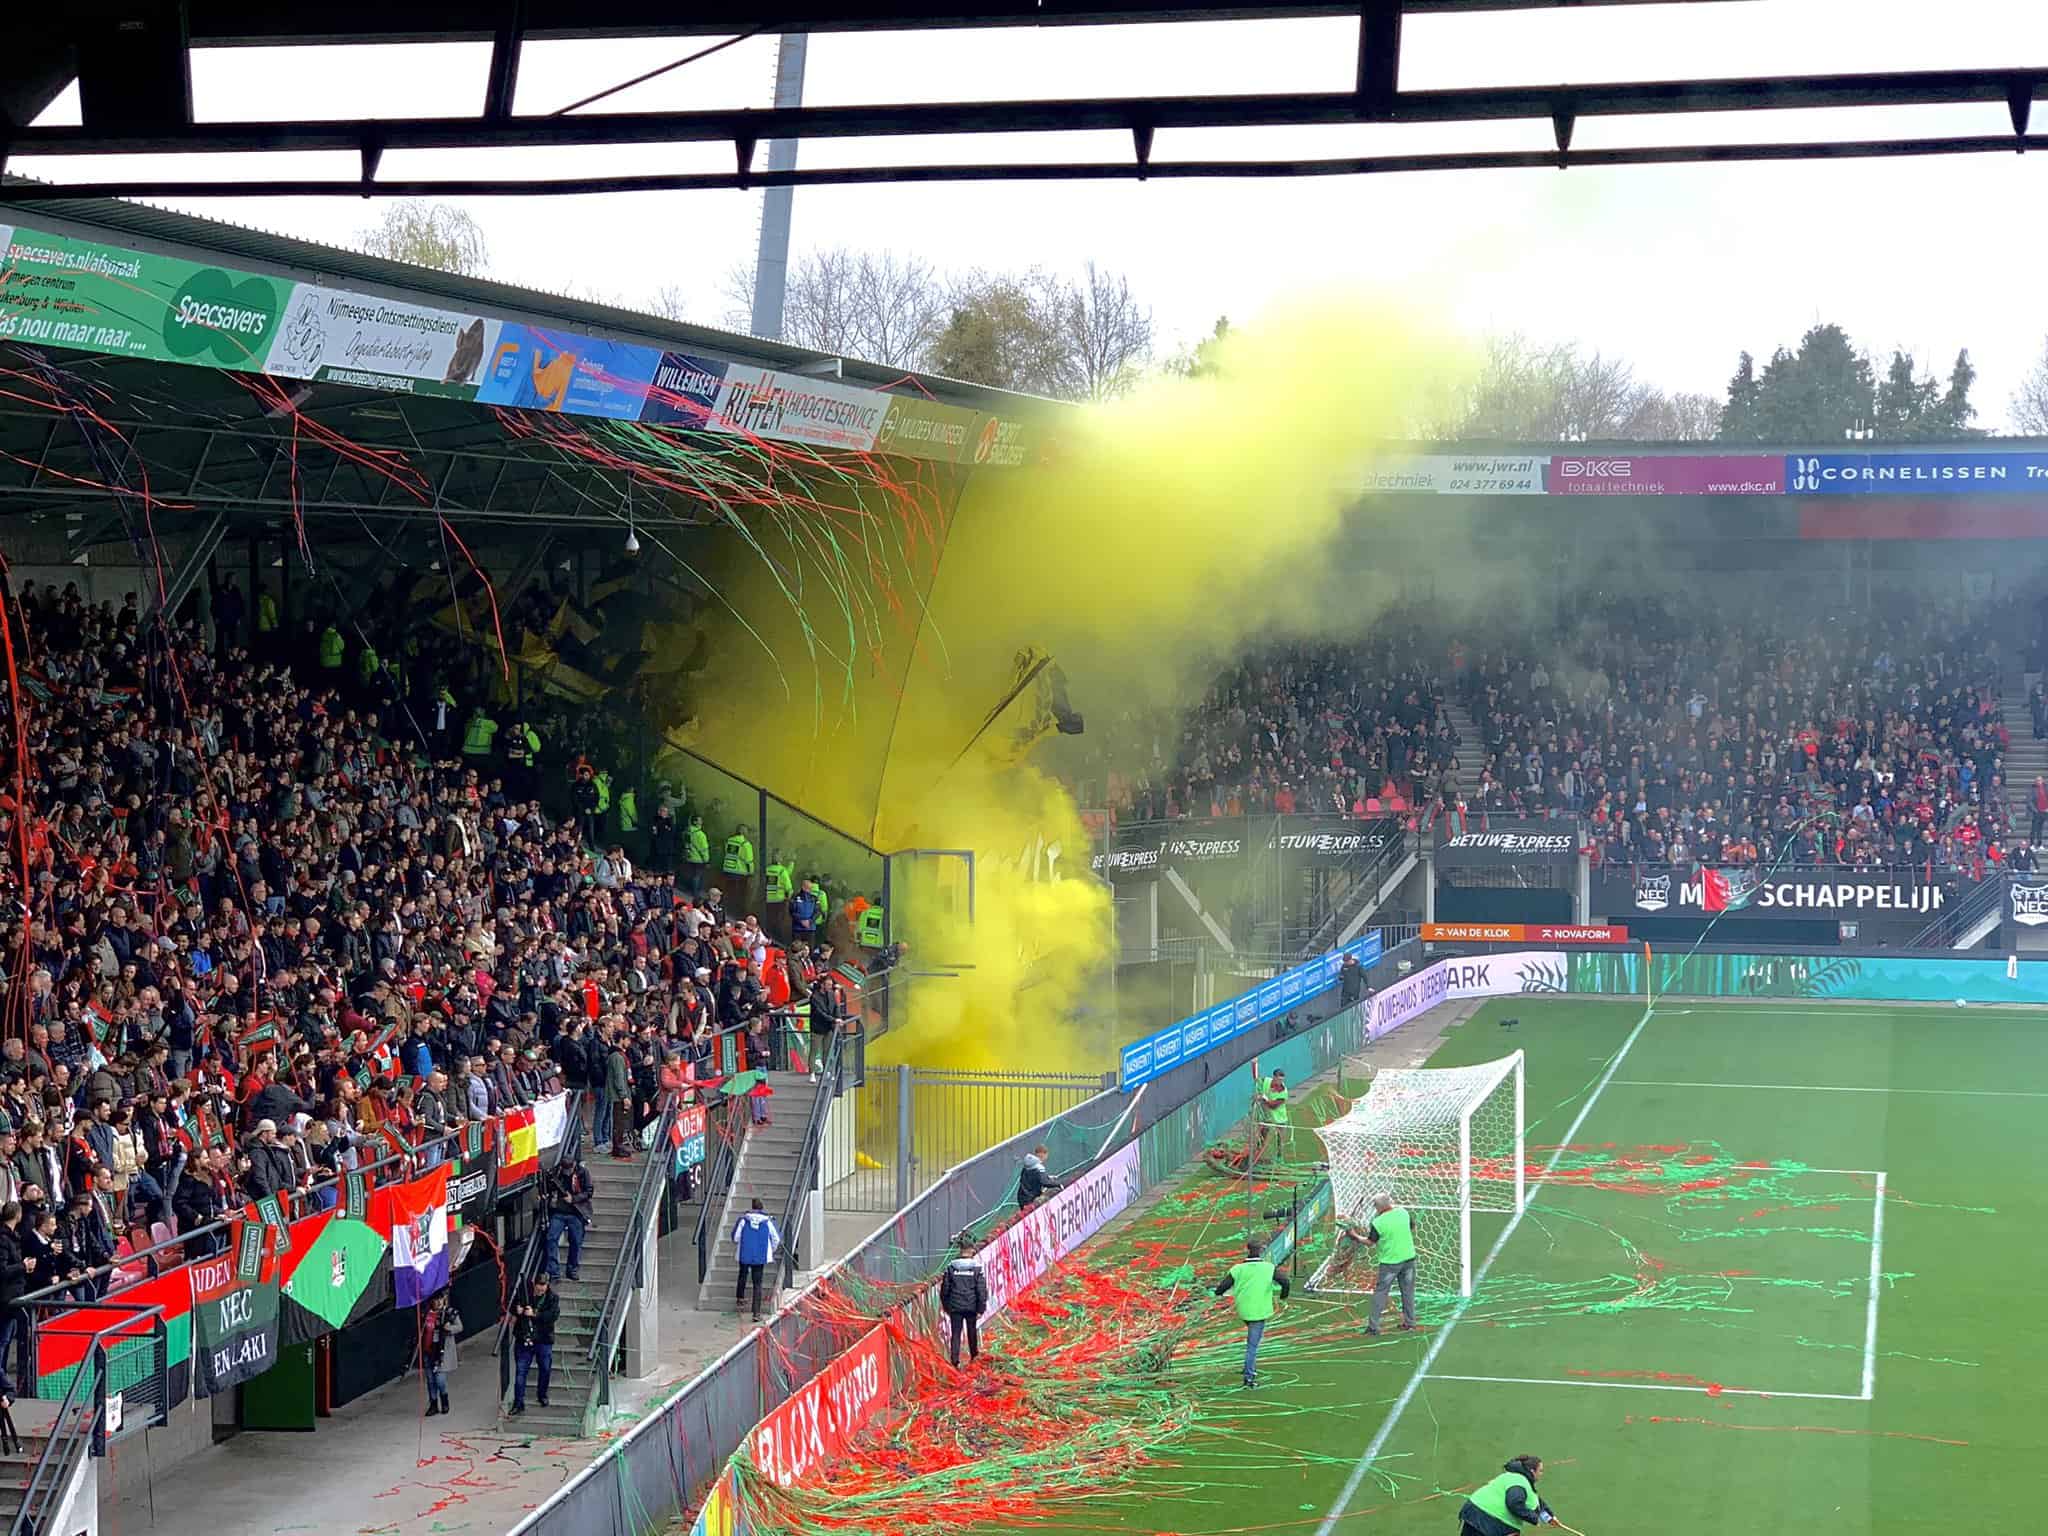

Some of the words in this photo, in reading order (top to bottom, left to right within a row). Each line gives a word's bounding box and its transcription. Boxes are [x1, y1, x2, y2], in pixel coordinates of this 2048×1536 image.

[8, 243, 141, 279] specsavers.nl/afspraak
[0, 308, 18, 335] as
[18, 317, 52, 339] nou
[52, 321, 95, 344] maar
[94, 327, 131, 348] naar
[175, 294, 268, 335] Specsavers
[326, 297, 376, 324] Nijmeegse
[375, 304, 459, 336] Ontsmettingsdienst
[656, 366, 718, 397] WILLEMSEN
[1452, 459, 1534, 474] www.jwr.nl
[1822, 466, 2007, 480] CORNELISSEN
[1449, 479, 1471, 490] 024
[1499, 479, 1514, 490] 69
[1516, 479, 1532, 490] 44
[1708, 481, 1776, 492] www.dkc.nl
[1639, 889, 1665, 900] NEC
[1679, 882, 1945, 913] MSCHAPPELIJK
[2016, 901, 2048, 913] NEC
[1447, 927, 1467, 938] VAN
[1468, 928, 1483, 938] DE
[1484, 928, 1510, 938] KLOK
[1555, 929, 1611, 939] NOVAFORM
[1377, 983, 1418, 1027] OUWEHANDS
[1420, 963, 1491, 1003] DIERENPARK
[194, 1258, 231, 1293] UDEN
[218, 1288, 254, 1334] NEC
